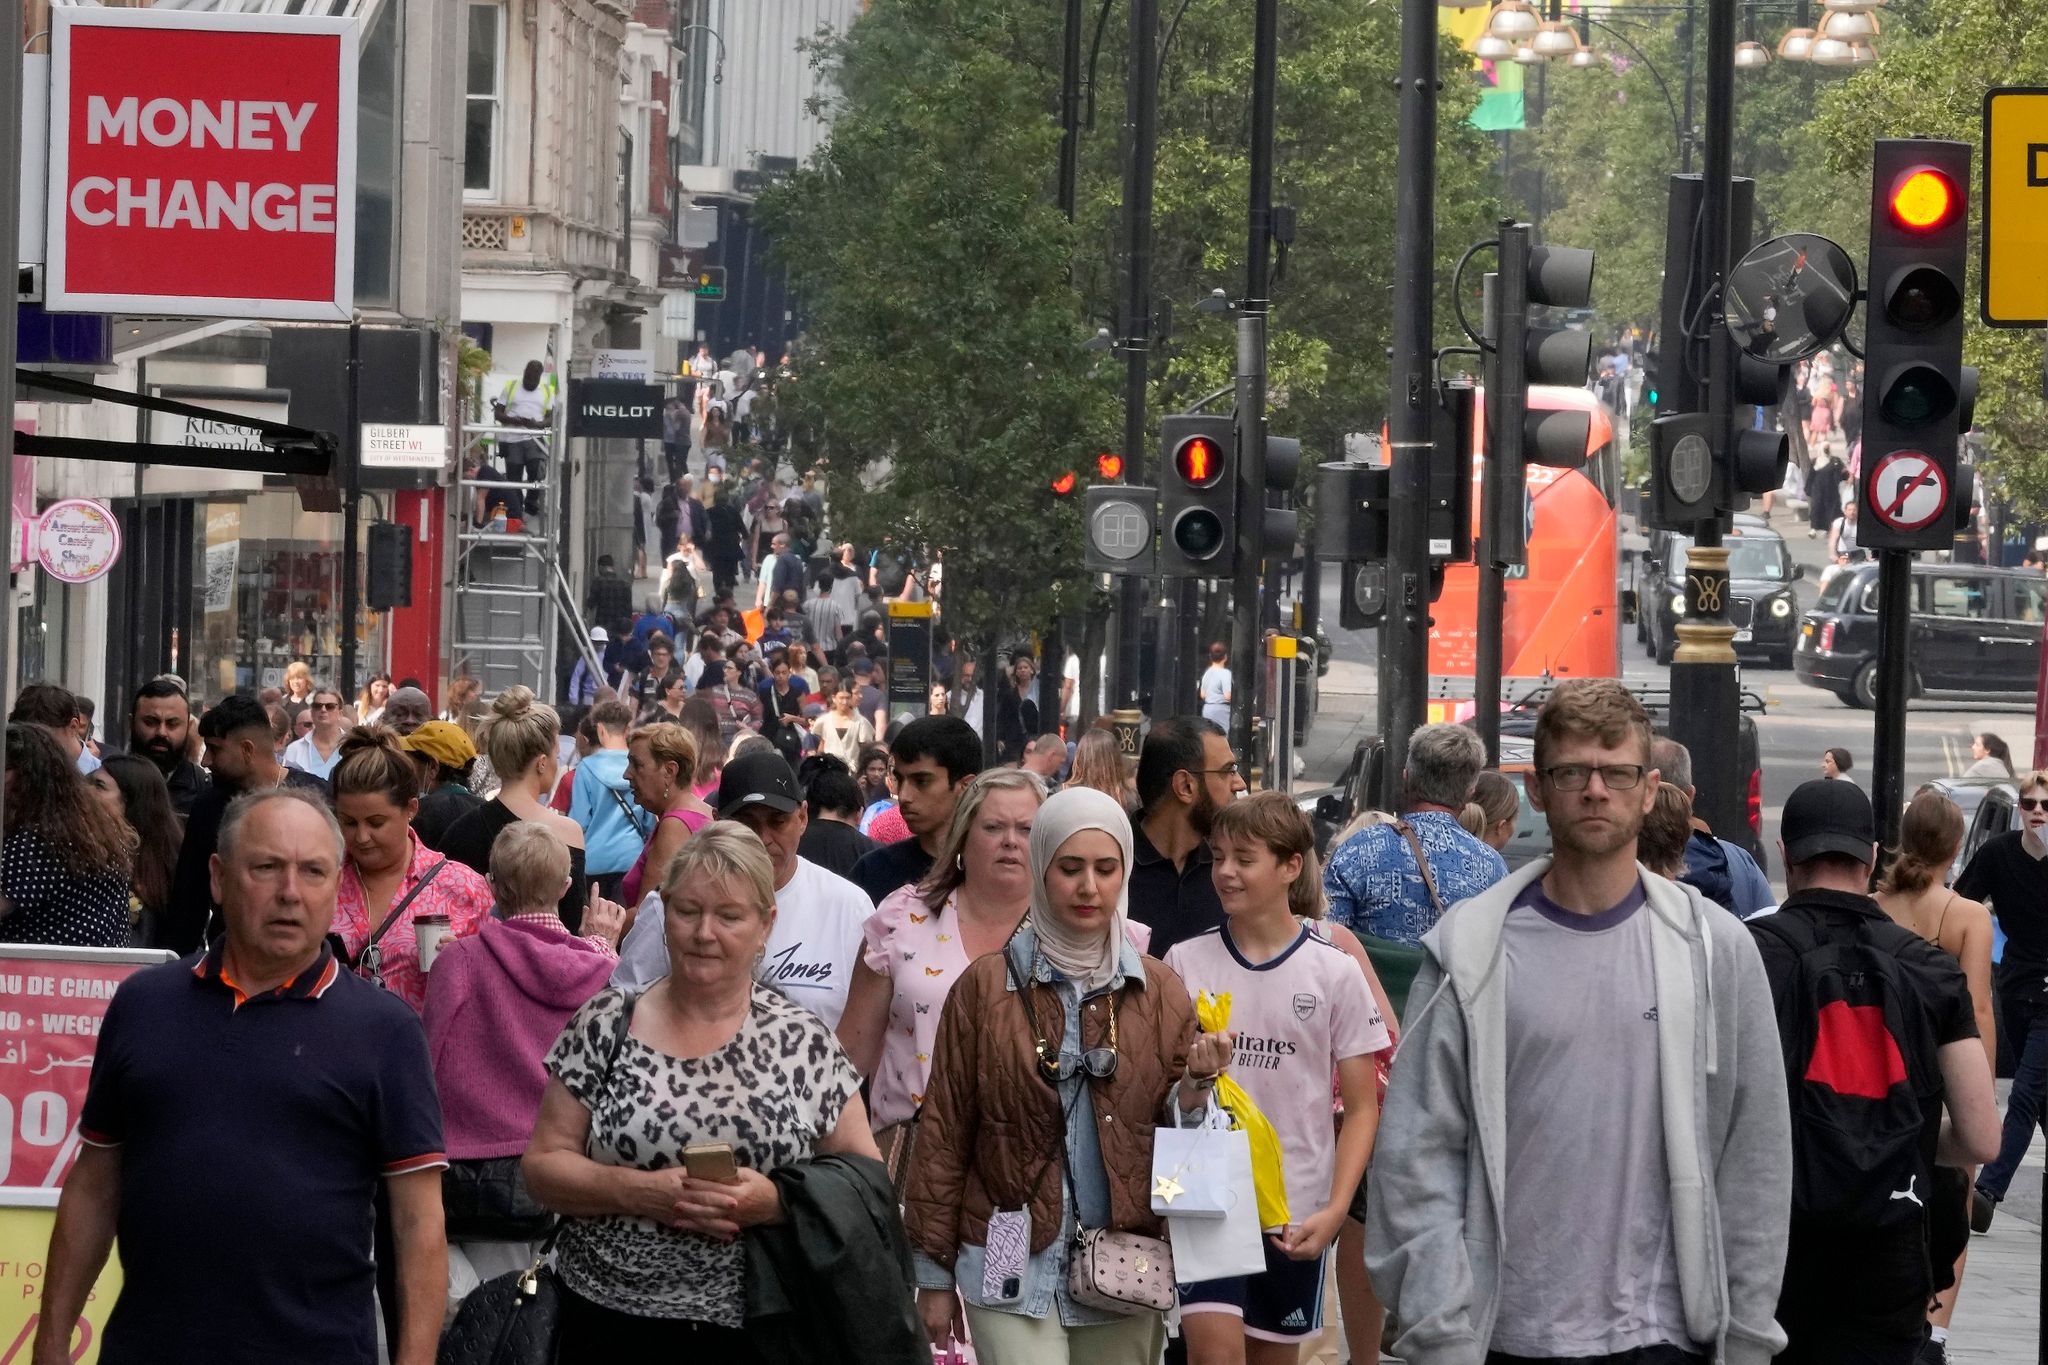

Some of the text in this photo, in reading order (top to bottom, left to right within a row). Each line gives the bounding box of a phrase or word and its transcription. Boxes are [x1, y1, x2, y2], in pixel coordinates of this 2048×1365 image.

[87, 96, 318, 151] MONEY
[70, 176, 336, 233] CHANGE
[582, 404, 655, 418] INGLOT
[370, 427, 410, 439] GILBERT
[370, 439, 422, 451] STREET W1
[762, 942, 832, 983] Jones
[27, 976, 55, 996] DE
[1231, 1031, 1297, 1055] irates
[1238, 1052, 1281, 1070] BETTER
